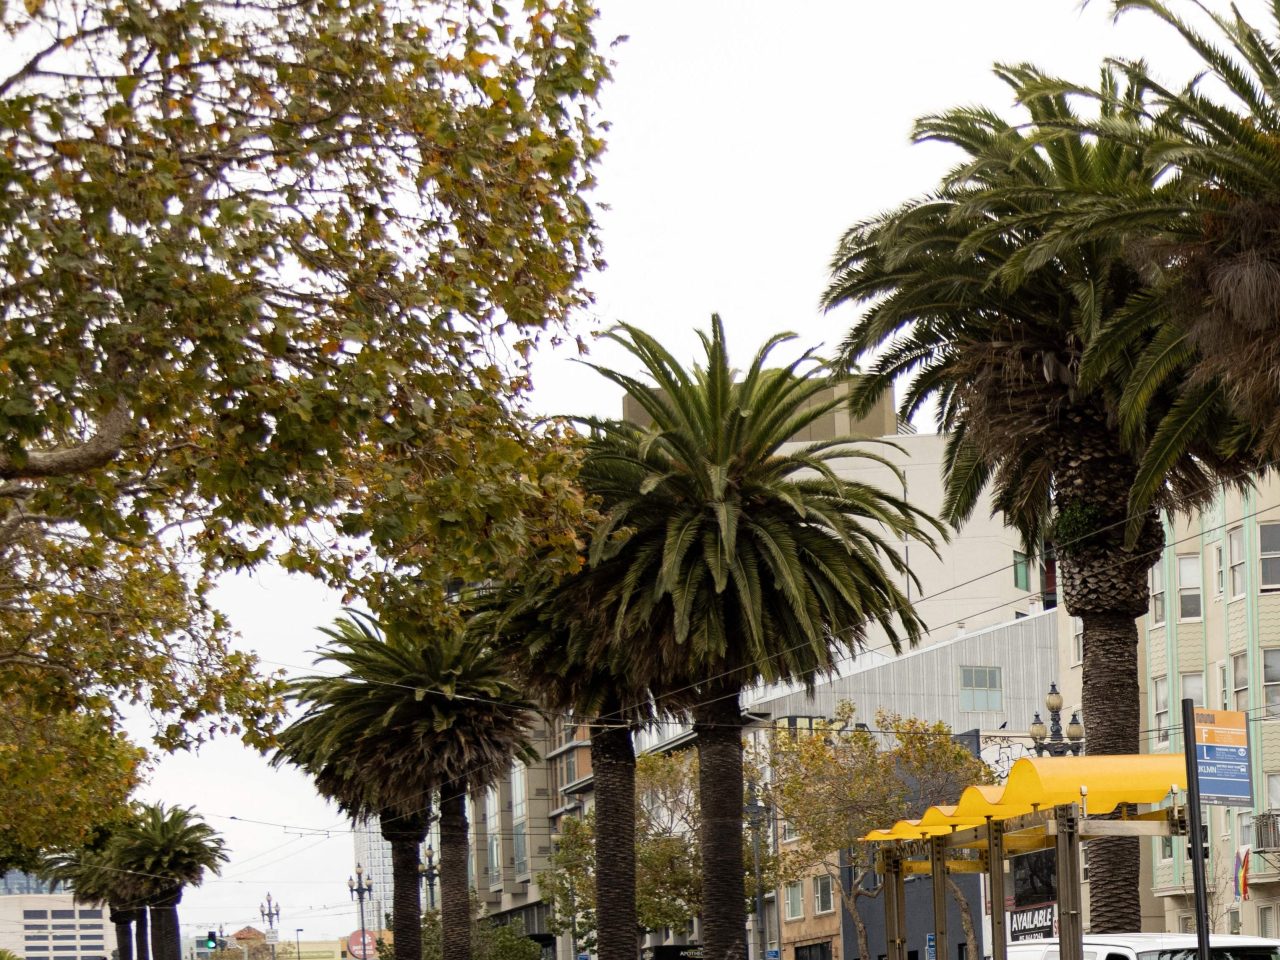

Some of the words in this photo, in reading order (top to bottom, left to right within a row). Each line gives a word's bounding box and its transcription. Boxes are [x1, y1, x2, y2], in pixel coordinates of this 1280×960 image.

[1202, 728, 1209, 743] F
[1203, 745, 1211, 760] L
[1011, 908, 1052, 932] AVAILABLE
